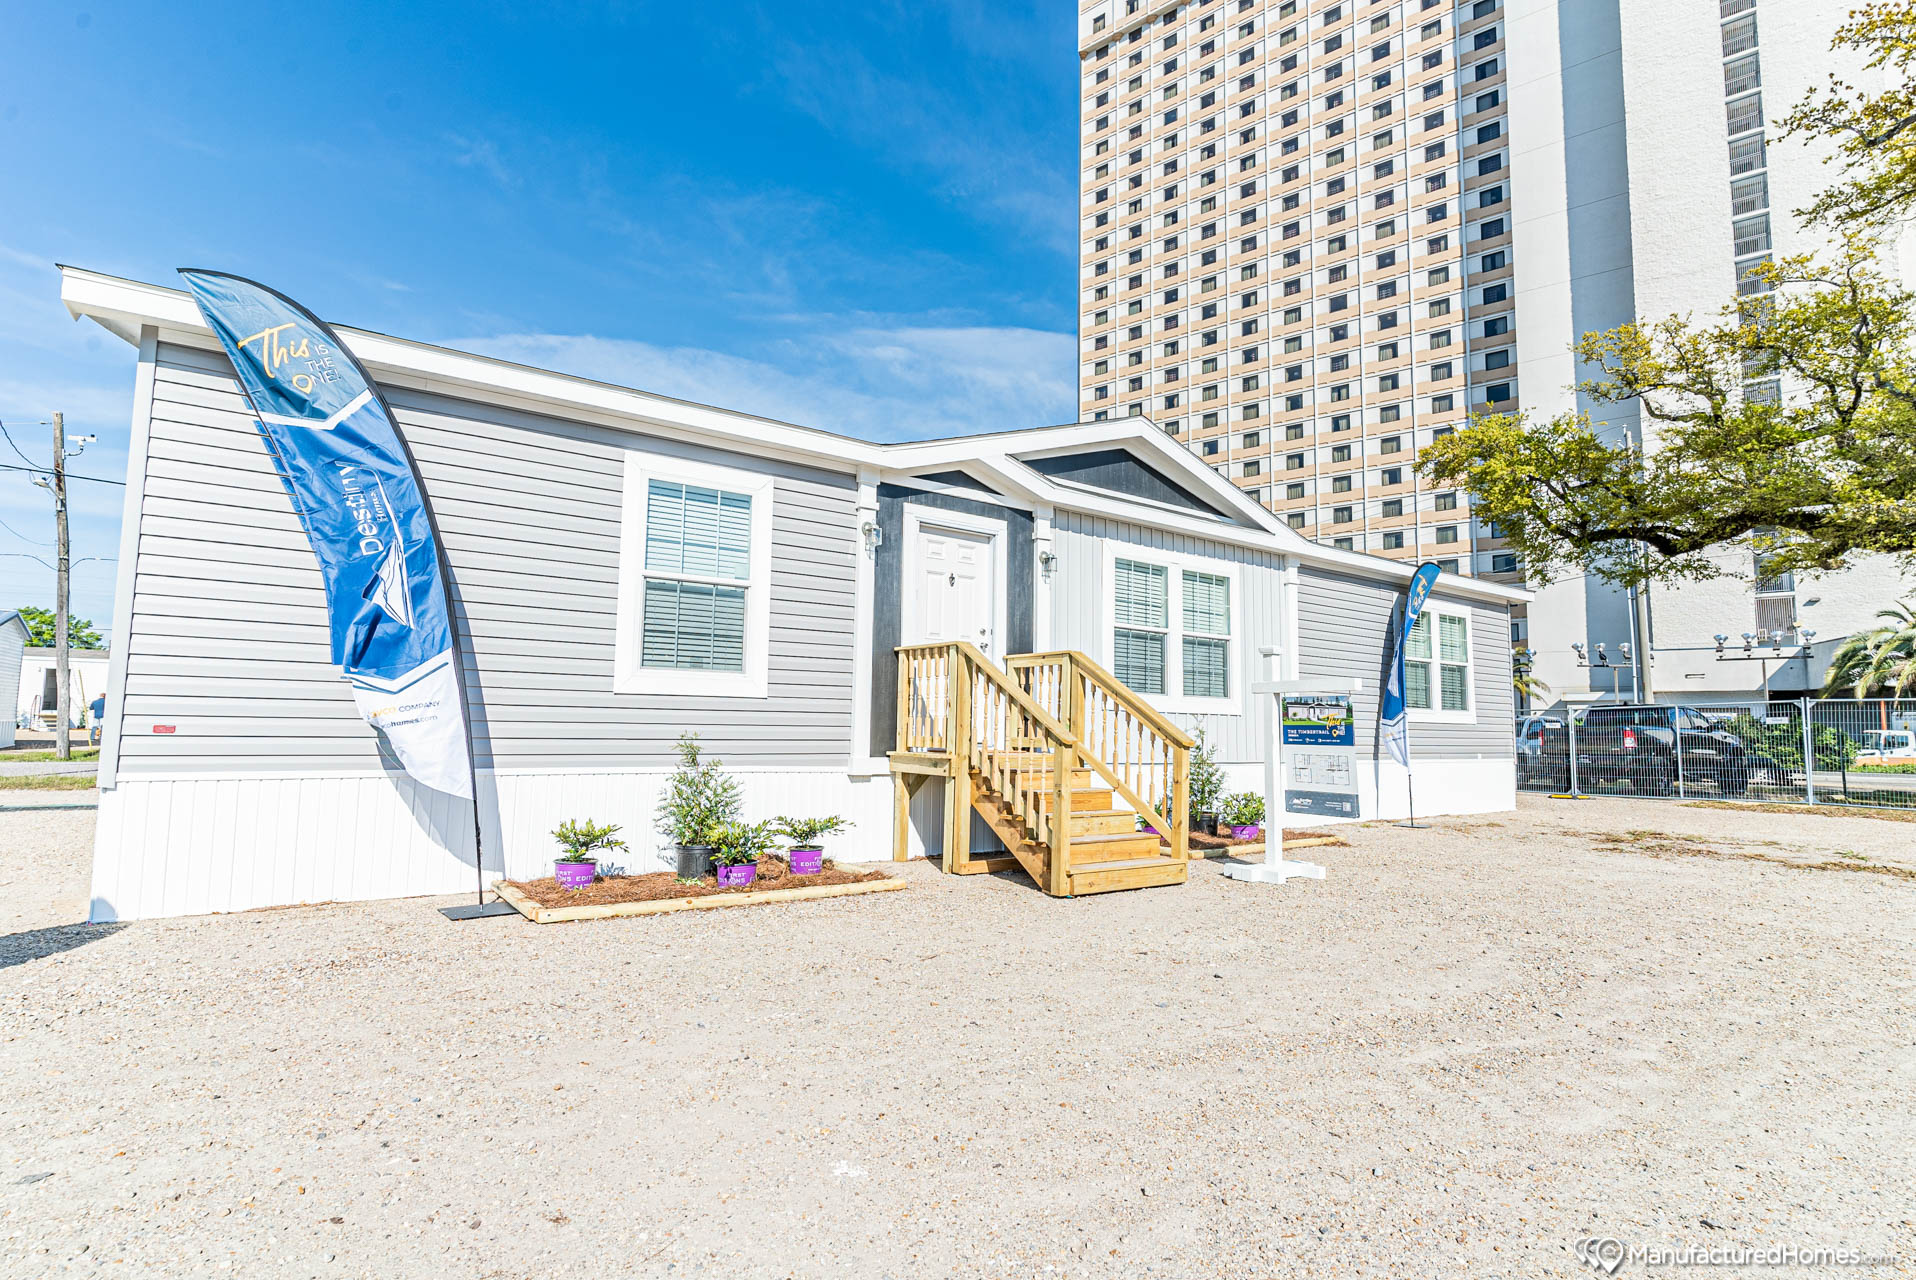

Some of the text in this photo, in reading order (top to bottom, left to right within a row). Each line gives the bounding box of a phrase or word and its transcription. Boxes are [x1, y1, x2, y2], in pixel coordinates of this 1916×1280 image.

[237, 322, 329, 378] This IS
[305, 356, 335, 372] THE
[292, 368, 342, 395] ONE!
[398, 700, 441, 713] COMPANY
